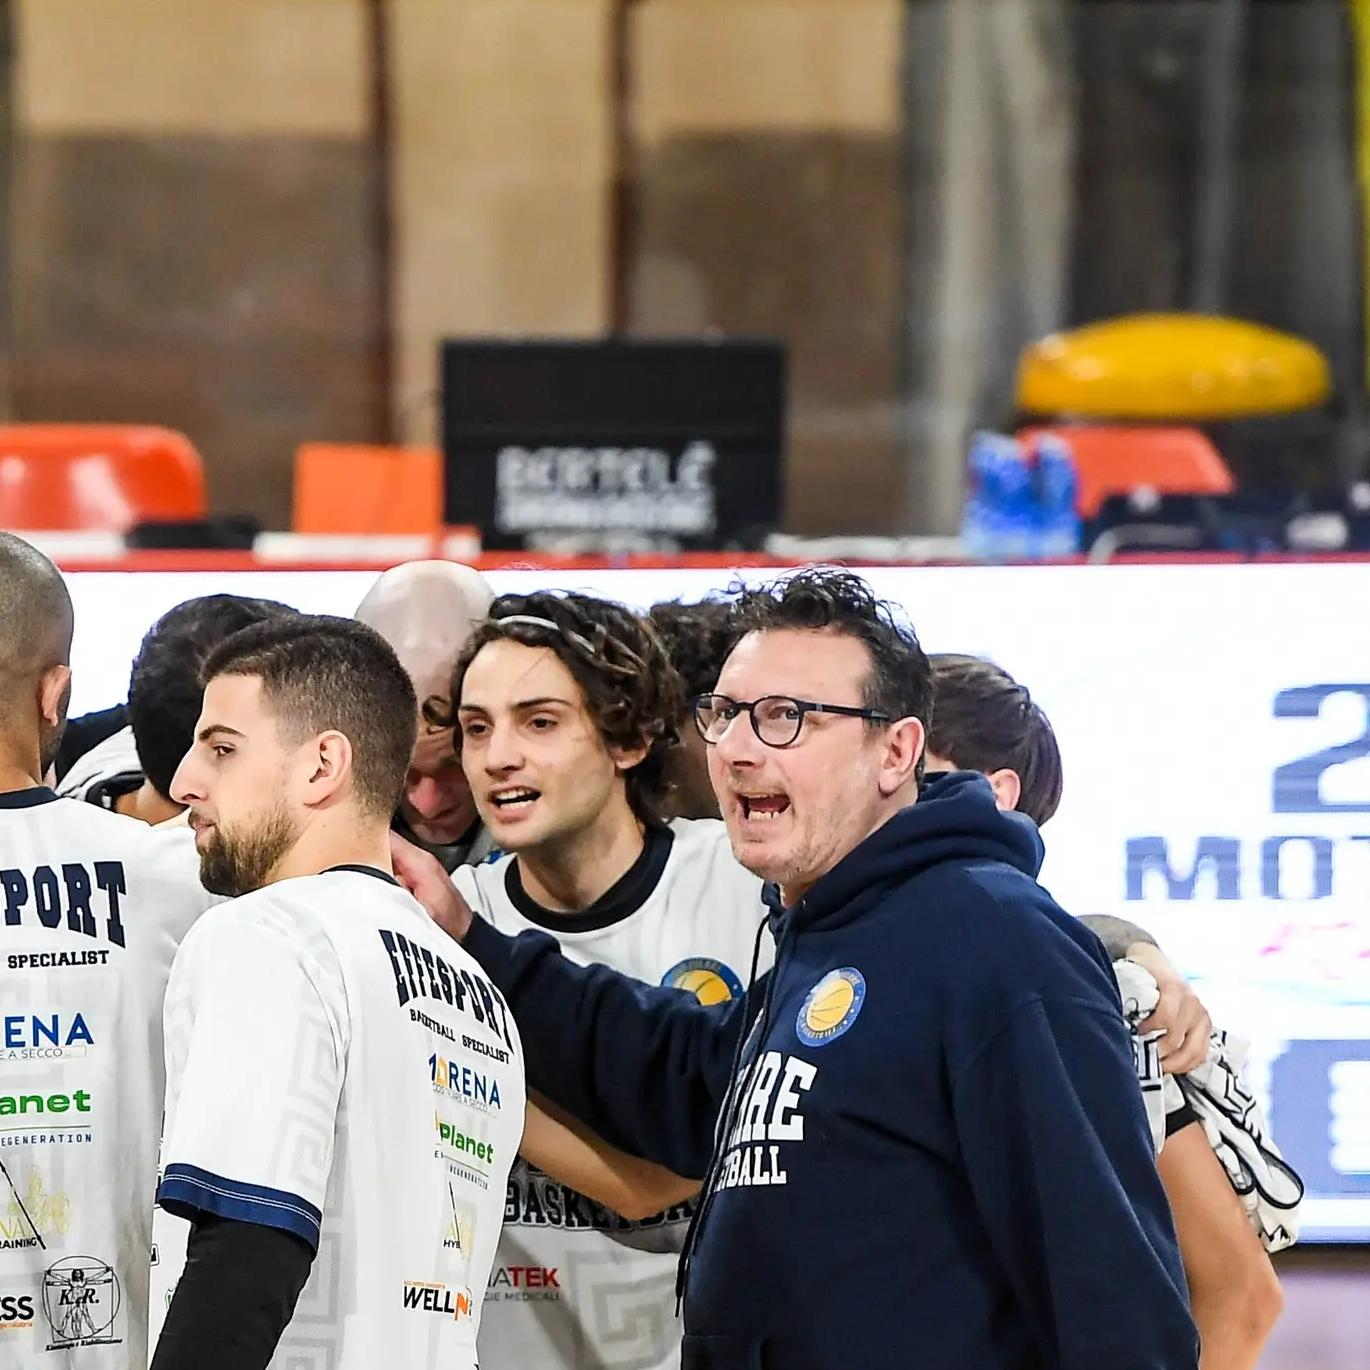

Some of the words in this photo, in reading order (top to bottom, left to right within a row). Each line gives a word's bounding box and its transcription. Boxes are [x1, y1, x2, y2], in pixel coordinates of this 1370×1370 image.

[1126, 836, 1370, 900] MO
[7, 950, 110, 969] SPECIALIST
[8, 1049, 18, 1060] A
[714, 1145, 788, 1193] BALL
[403, 1285, 470, 1321] WELLN
